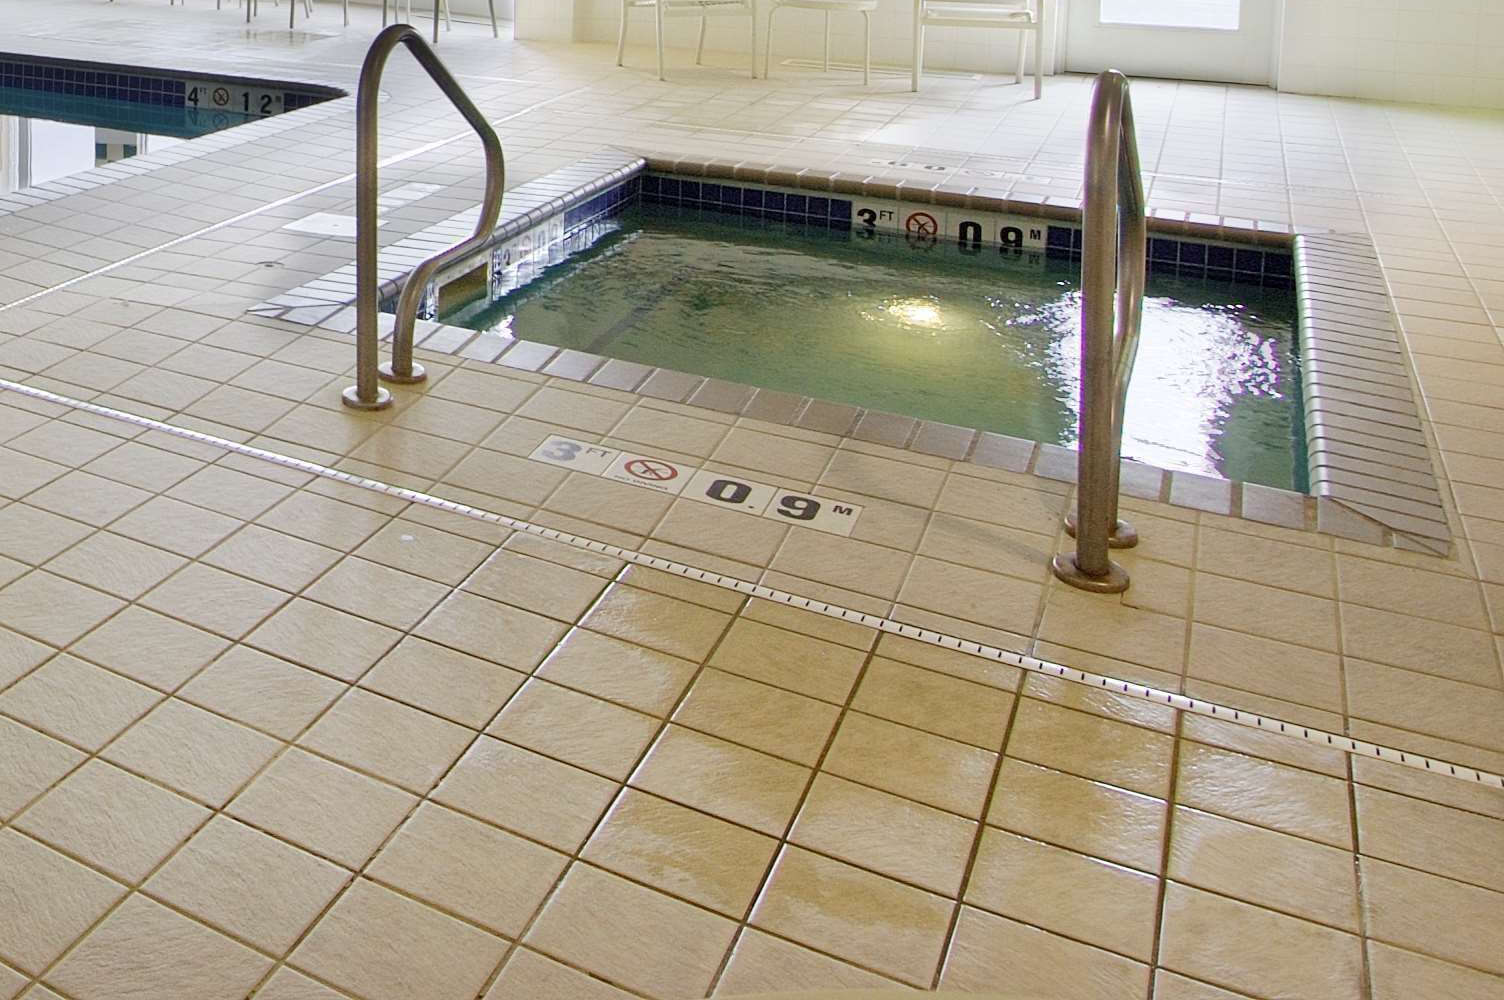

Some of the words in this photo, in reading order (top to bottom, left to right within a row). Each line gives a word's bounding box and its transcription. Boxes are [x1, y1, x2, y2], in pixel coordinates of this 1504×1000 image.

[188, 87, 200, 106] 4
[1029, 228, 1042, 241] M
[585, 446, 613, 459] FT
[831, 504, 854, 518] M
